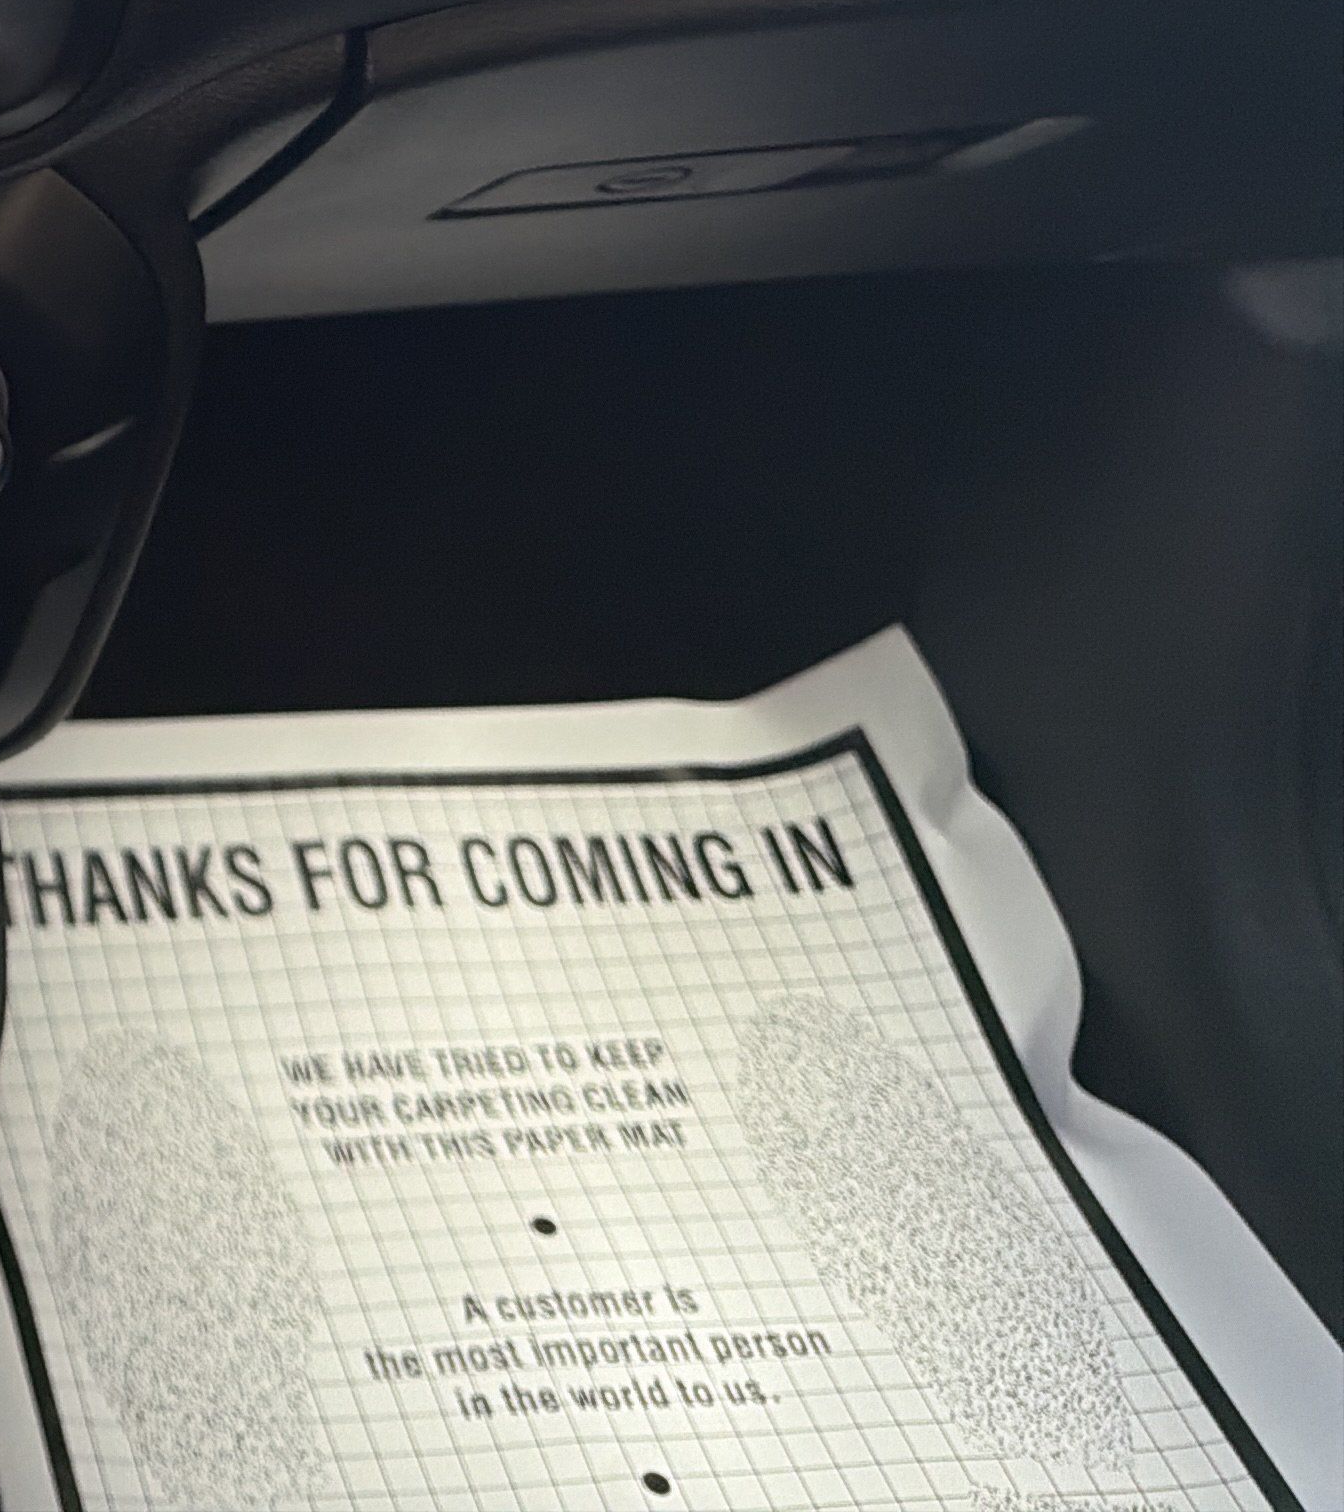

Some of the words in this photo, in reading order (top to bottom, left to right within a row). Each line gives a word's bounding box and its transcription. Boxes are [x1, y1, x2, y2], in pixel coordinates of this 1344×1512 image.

[292, 834, 443, 912] FOR
[462, 830, 753, 908] COMING
[761, 816, 856, 895] IN
[280, 1051, 334, 1085] WE
[341, 1046, 426, 1082] HAVE
[431, 1043, 529, 1079] TRIED
[533, 1040, 578, 1074] TO
[585, 1035, 666, 1071] KEEP
[292, 1094, 384, 1129] YOUR
[392, 1087, 578, 1126] CARPETING
[584, 1078, 691, 1114] CLEAN
[321, 1135, 414, 1167] WITH
[421, 1129, 495, 1162] THIS
[502, 1121, 612, 1157] PAPER
[619, 1118, 688, 1152] MAT
[462, 1292, 486, 1324] A
[495, 1285, 655, 1323] customer
[664, 1282, 699, 1315] is
[363, 1346, 424, 1381] the
[432, 1339, 524, 1376] most
[532, 1331, 703, 1370] important
[712, 1326, 832, 1366] person
[455, 1386, 494, 1421] in
[500, 1382, 561, 1417] the
[570, 1374, 670, 1412] world
[676, 1375, 715, 1408] to
[725, 1378, 782, 1407] us.
